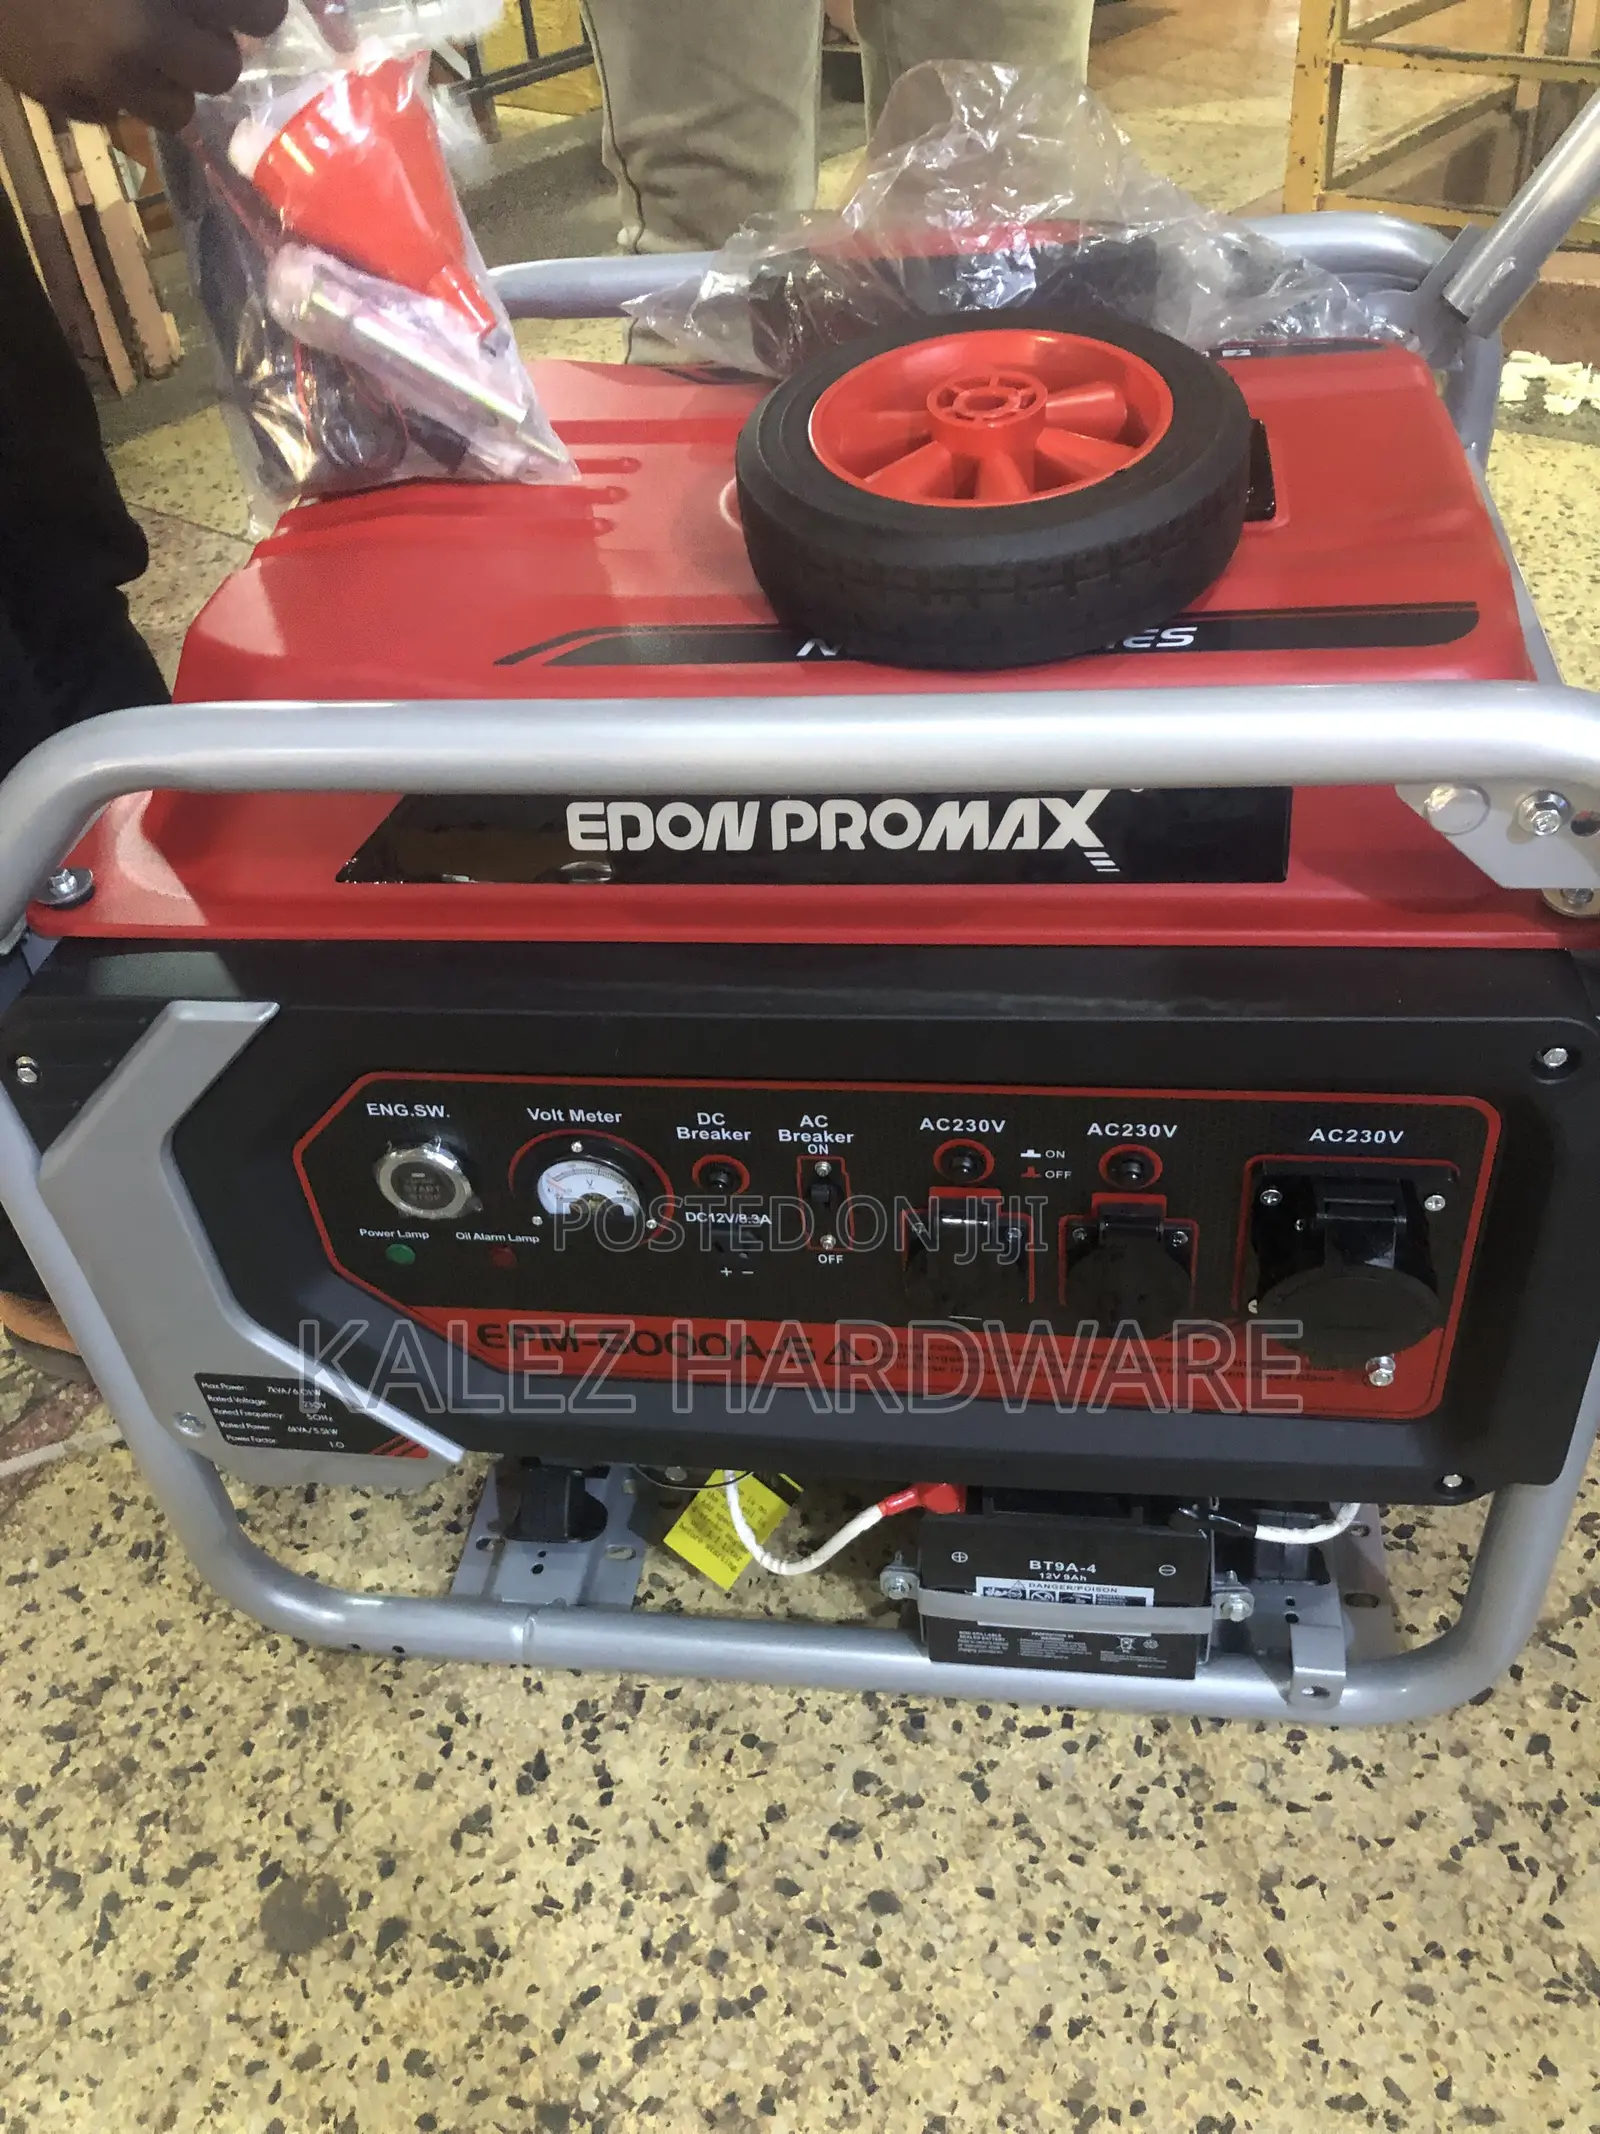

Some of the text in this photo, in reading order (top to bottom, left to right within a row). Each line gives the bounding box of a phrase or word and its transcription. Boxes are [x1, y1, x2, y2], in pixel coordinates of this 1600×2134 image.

[565, 789, 1119, 872] EDON PROMAX
[366, 1103, 451, 1118] ENG.SW.
[527, 1107, 622, 1123] Volt Meter
[697, 1112, 726, 1126] DC
[799, 1115, 829, 1128] AC
[919, 1117, 1007, 1133] AC230V
[676, 1127, 751, 1141] Breaker
[778, 1129, 854, 1144] Breaker
[1086, 1122, 1178, 1138] AC230V
[1308, 1127, 1405, 1145] AC230V
[807, 1144, 829, 1155] ON
[1045, 1150, 1066, 1159] ON
[1045, 1170, 1073, 1180] OFF
[685, 1211, 772, 1225] DC12V/8.3A
[359, 1228, 430, 1241] Power Lamp
[455, 1231, 540, 1243] Oil Alarm Lamp
[818, 1254, 844, 1265] OFF
[1029, 1560, 1097, 1574] BT9A-4
[1039, 1572, 1087, 1582] 12V 9Ah
[1029, 1583, 1118, 1593] DANGER/POISON
